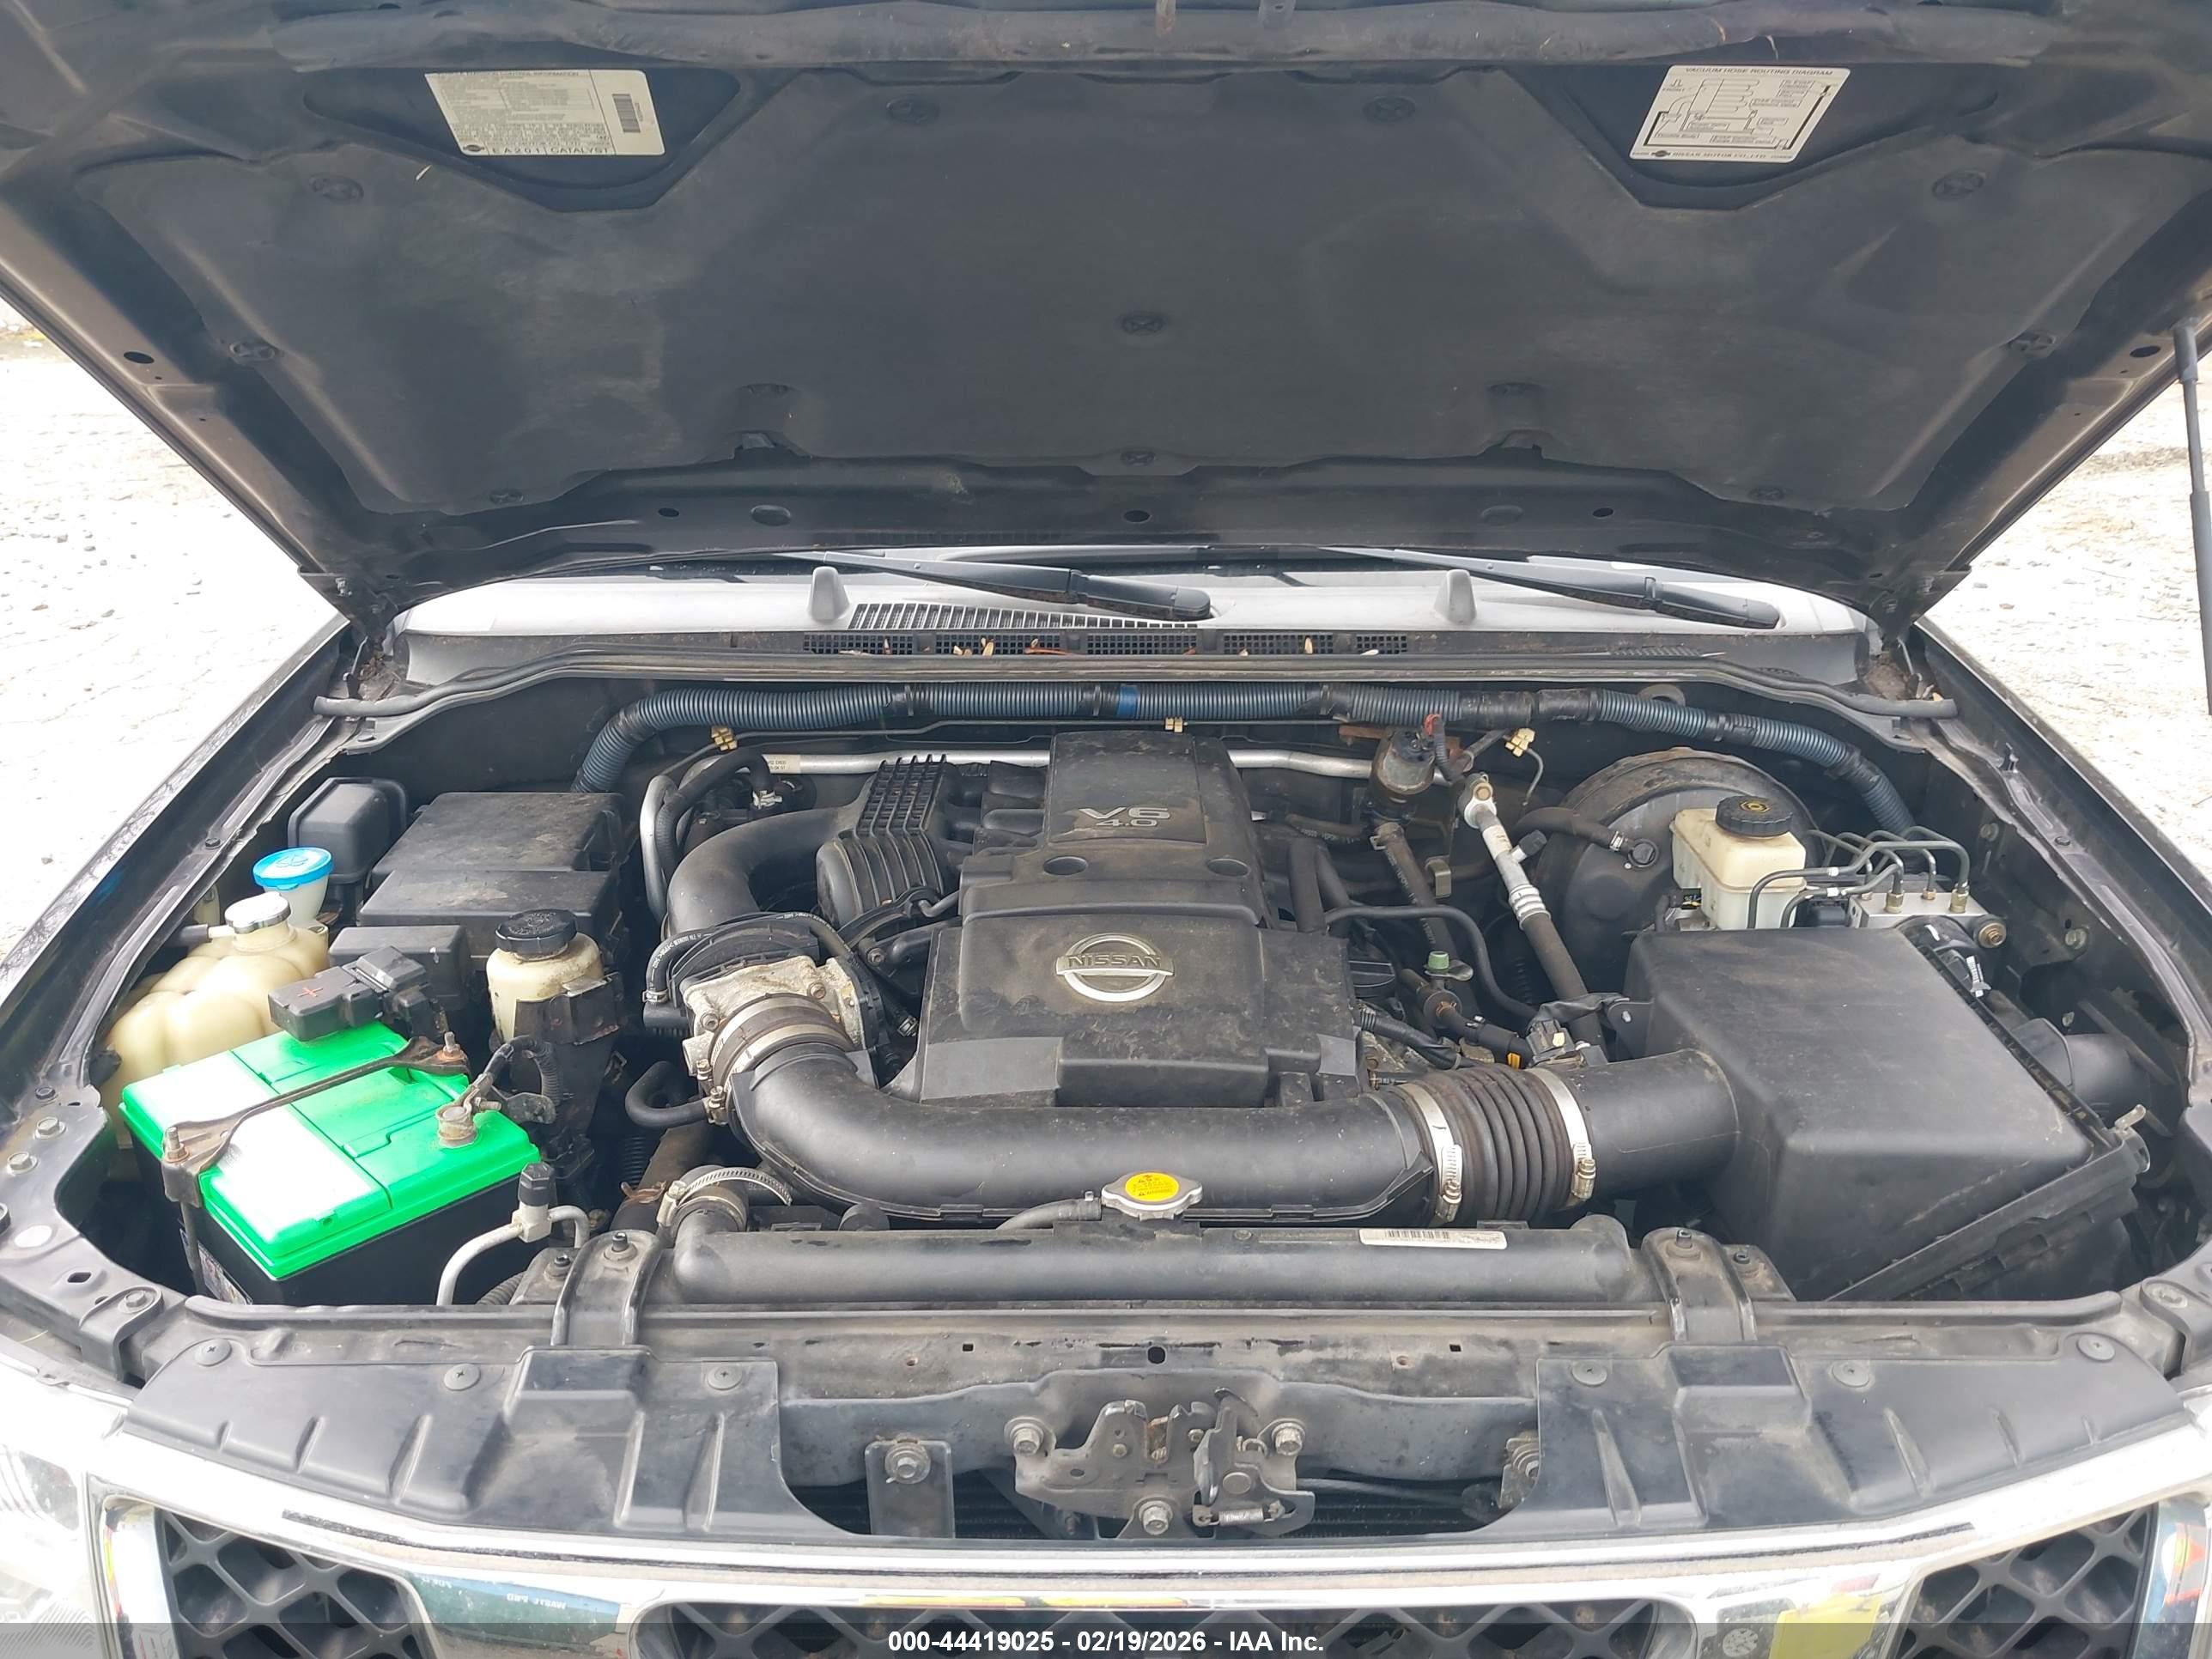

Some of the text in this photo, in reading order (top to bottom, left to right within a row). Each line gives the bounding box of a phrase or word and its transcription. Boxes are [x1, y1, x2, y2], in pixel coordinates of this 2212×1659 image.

[1079, 806, 1170, 819] V6
[1096, 818, 1158, 827] 4.0
[1068, 954, 1160, 968] NISSAN
